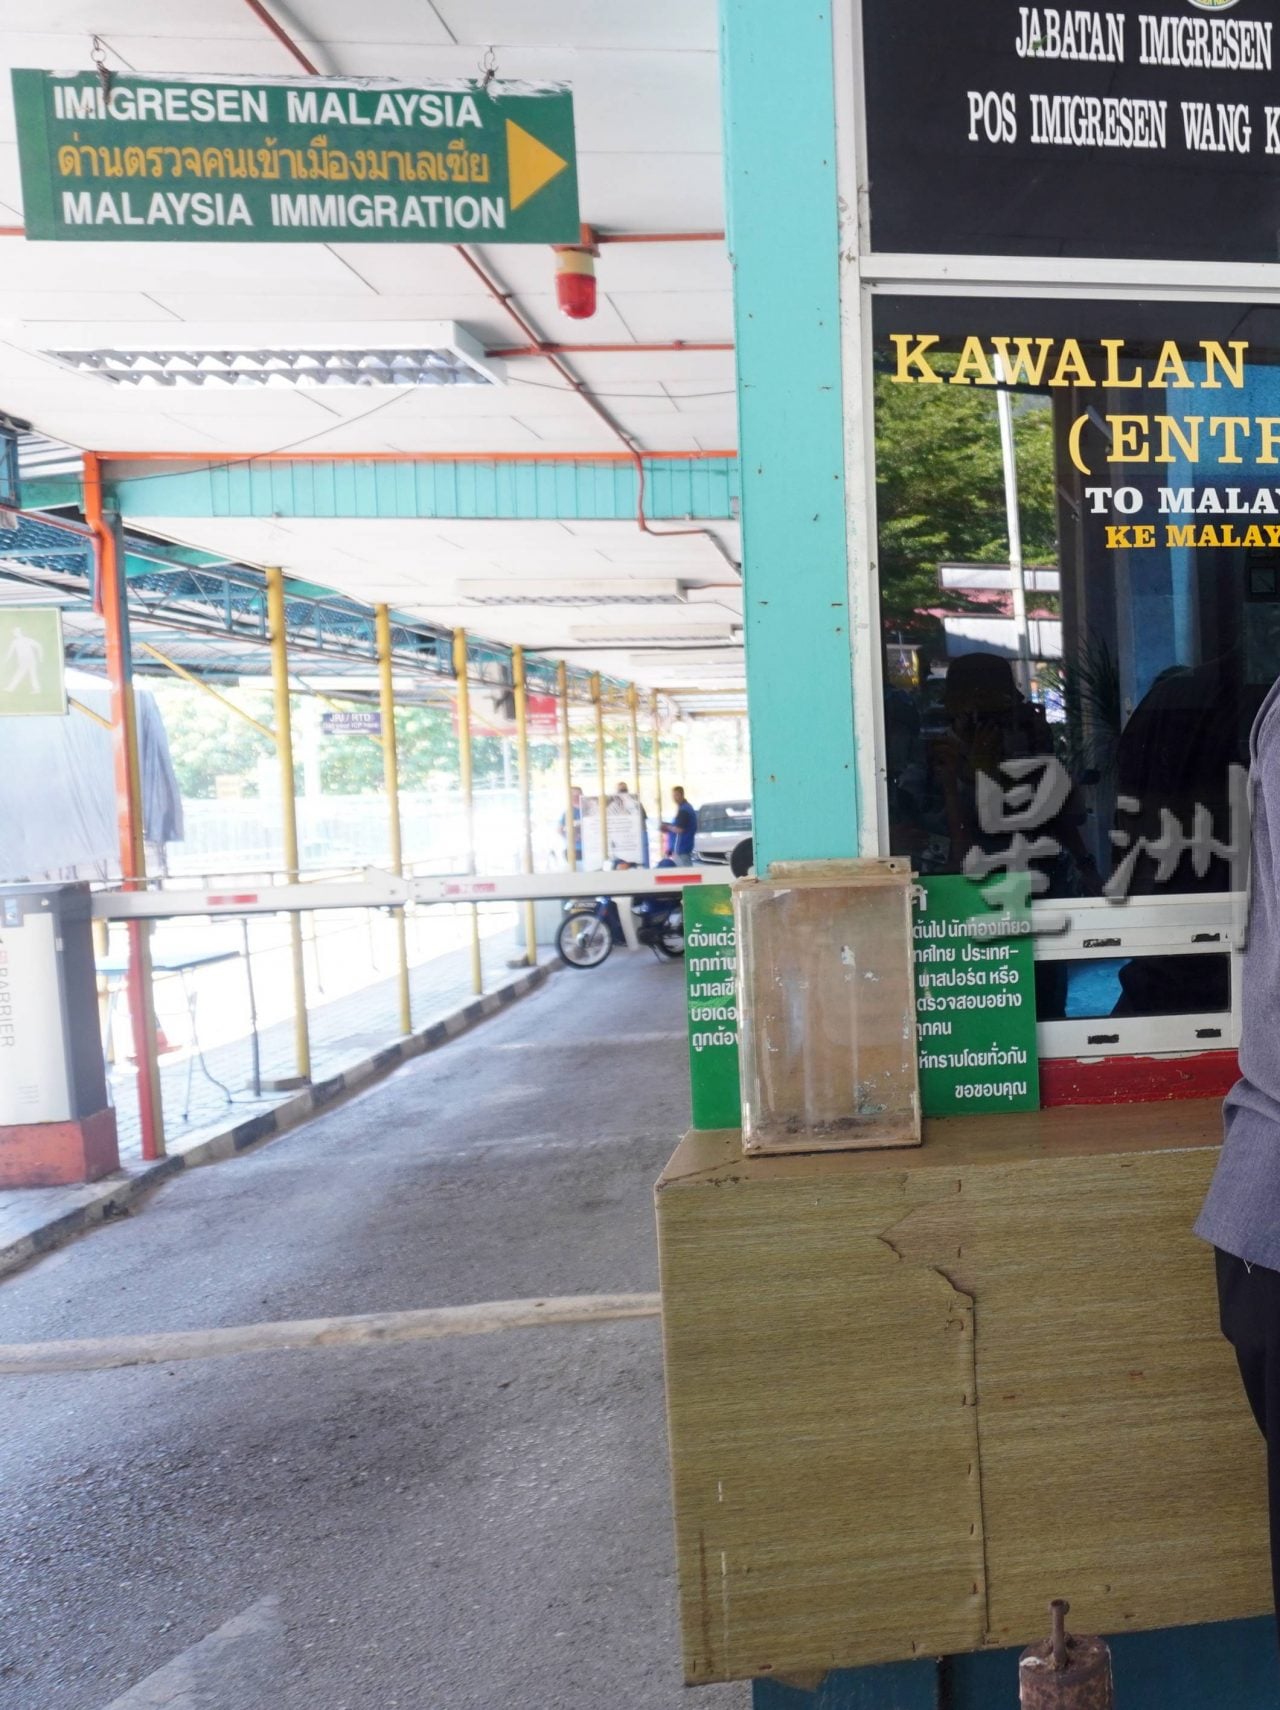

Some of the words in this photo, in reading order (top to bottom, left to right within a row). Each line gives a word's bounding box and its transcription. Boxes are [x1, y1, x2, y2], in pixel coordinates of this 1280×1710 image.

[1015, 7, 1125, 62] JABATAN
[1139, 14, 1272, 71] IMIGRESEN
[53, 85, 269, 124] IMIGRESEN
[286, 91, 483, 128] MALAYSIA
[967, 91, 1017, 145] POS
[1029, 94, 1167, 150] IMIGRESEN
[1181, 101, 1252, 154] WANG
[57, 132, 490, 184] ด่านตรวจคนเข้าเมืองมาเลเซีย
[62, 190, 254, 227] MALAYSIA
[270, 193, 506, 229] IMMIGRATION
[889, 334, 1249, 389] KAWALAN
[1085, 487, 1144, 515] TO
[1105, 525, 1152, 549] KE
[990, 964, 1019, 985] หรือ
[955, 1081, 1027, 1101] ขอขอบคุณ
